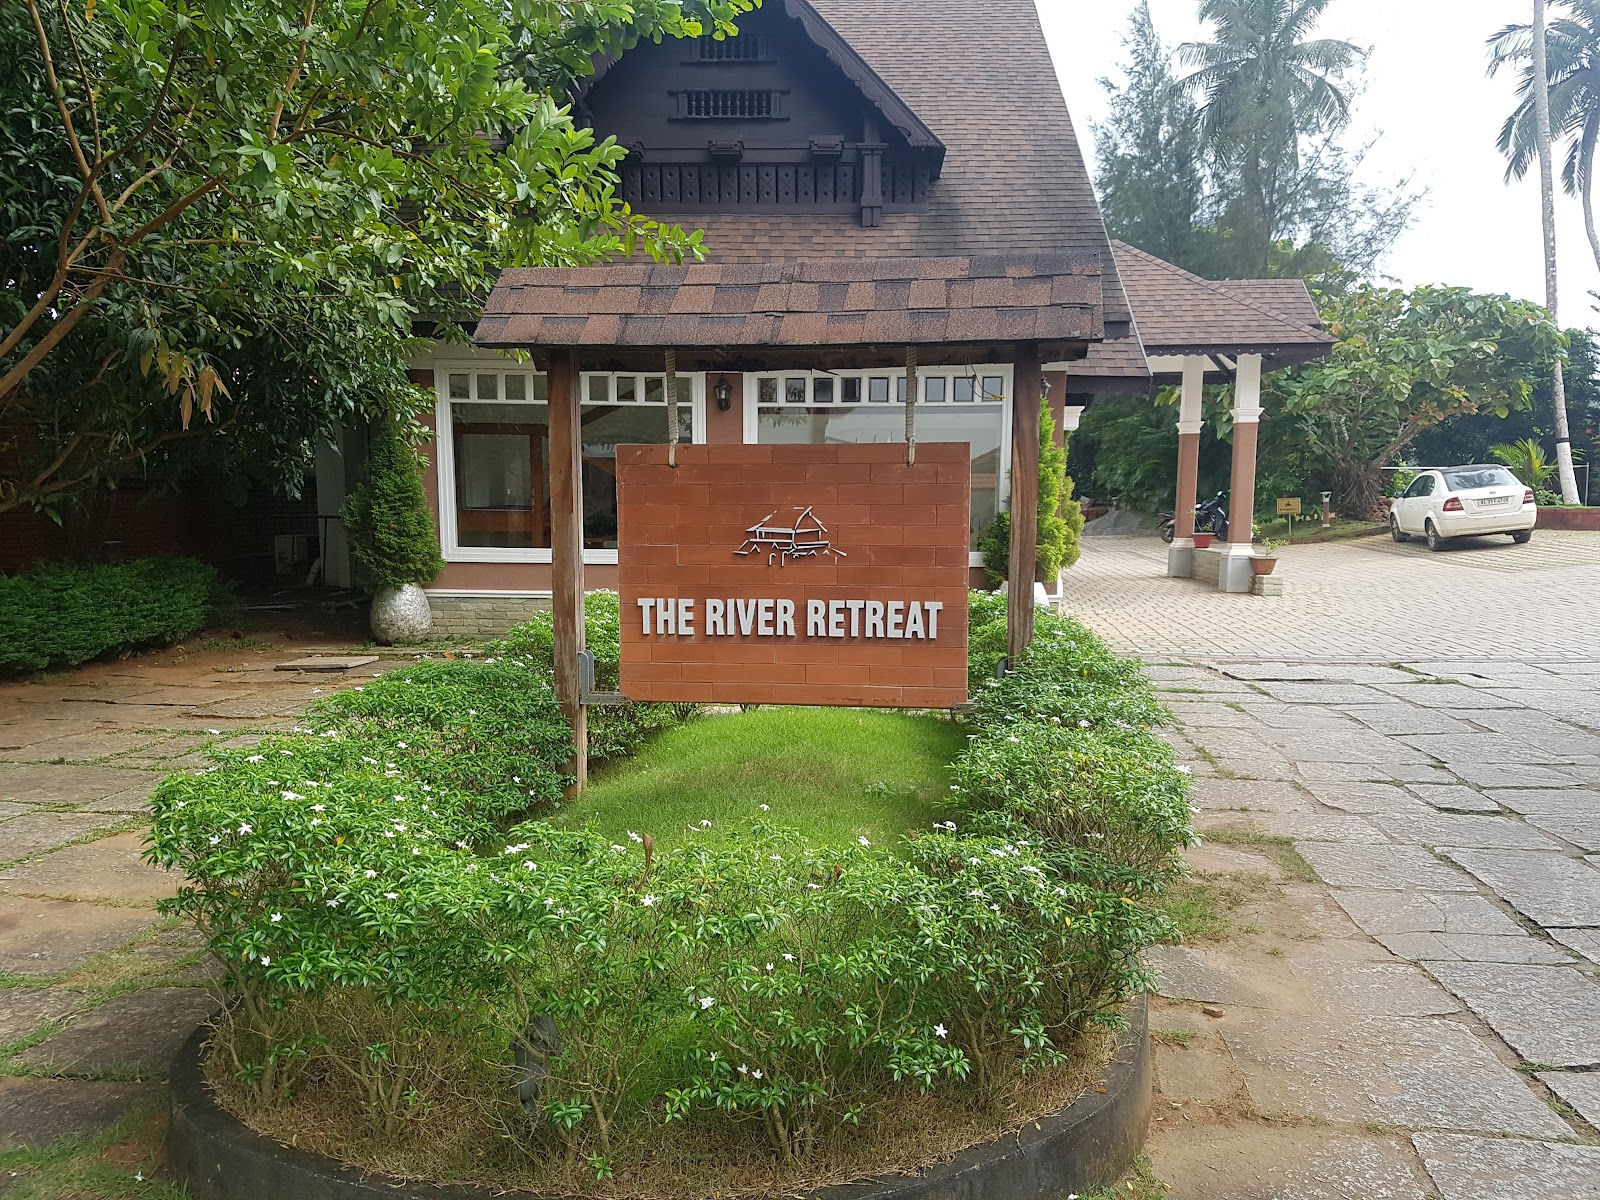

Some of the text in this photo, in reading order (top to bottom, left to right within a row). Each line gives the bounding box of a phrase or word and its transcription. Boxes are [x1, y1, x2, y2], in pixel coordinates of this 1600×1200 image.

[637, 597, 944, 639] THE RIVER RETREAT
